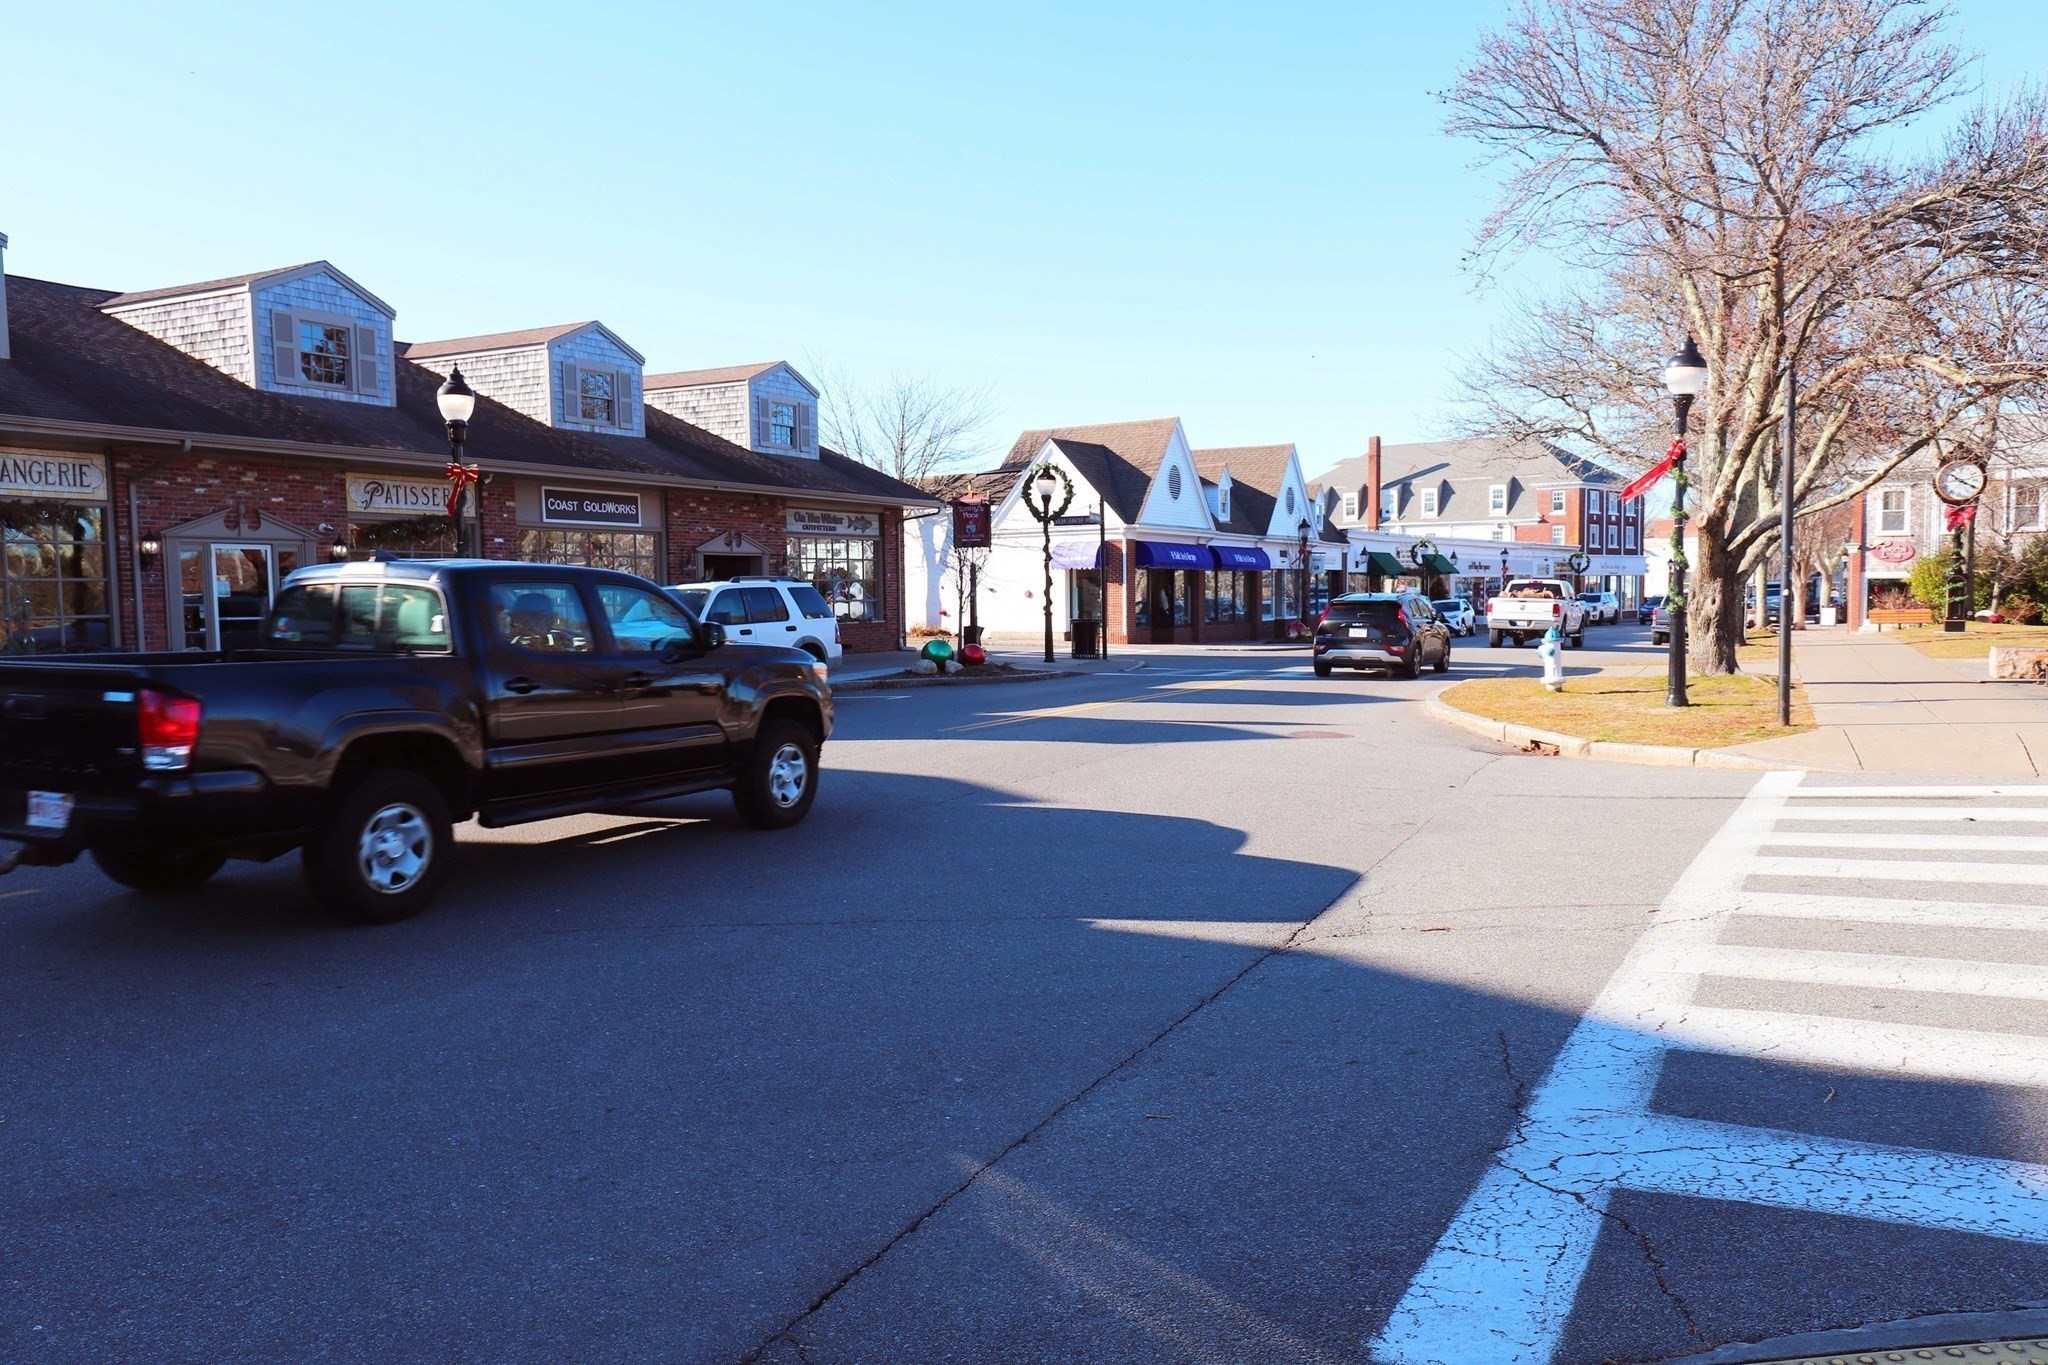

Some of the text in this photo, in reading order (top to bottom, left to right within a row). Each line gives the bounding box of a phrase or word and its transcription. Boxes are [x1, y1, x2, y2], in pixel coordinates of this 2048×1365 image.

[0, 456, 92, 488] ANGERIE
[361, 480, 453, 510] PATISSER
[547, 498, 637, 515] COAST GOLDWORKS
[958, 505, 984, 513] Tommy's
[793, 511, 844, 525] On The Water
[802, 524, 837, 532] OUTFITTERS
